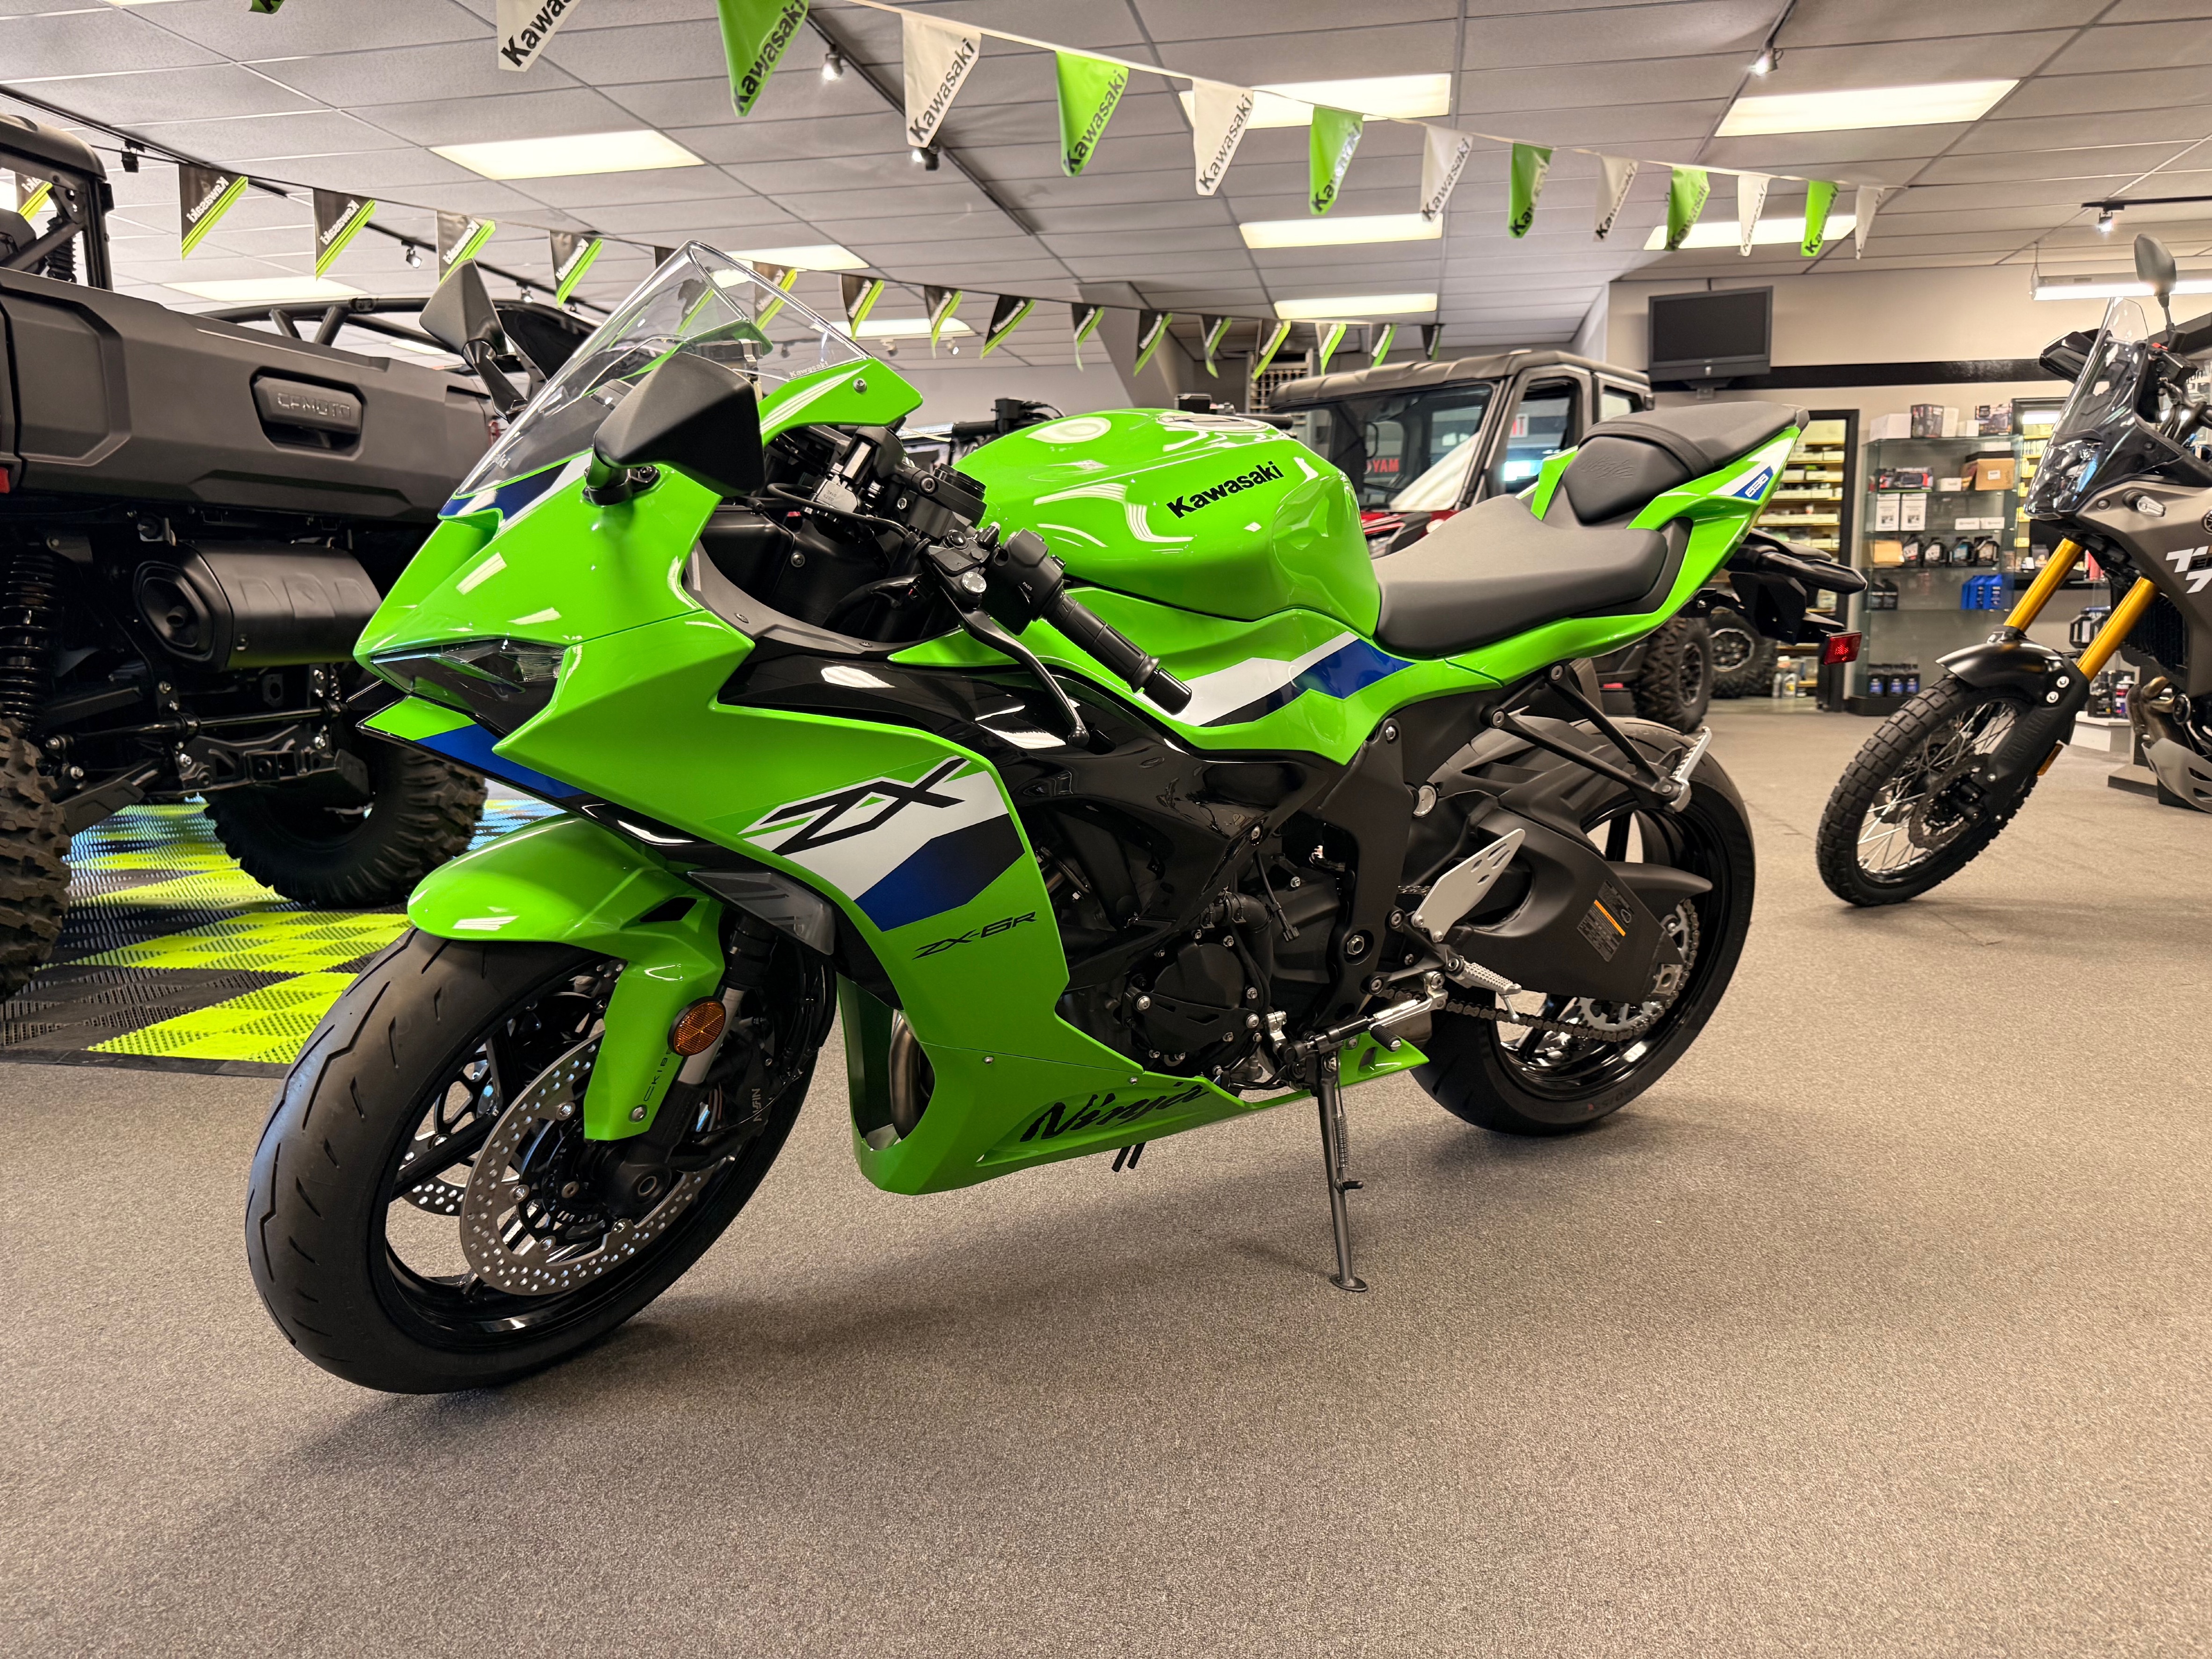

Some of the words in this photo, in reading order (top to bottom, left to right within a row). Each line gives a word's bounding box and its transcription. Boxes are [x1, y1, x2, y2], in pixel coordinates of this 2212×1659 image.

[501, 0, 572, 67] Kawa
[733, 0, 805, 113] Kawasaki
[909, 37, 974, 143] Kawasaki
[1064, 70, 1125, 175] Kawasaki
[1198, 93, 1254, 191] Kawasaki
[1422, 138, 1470, 221] Kawasaki
[789, 361, 828, 378] Kawasaki
[277, 393, 351, 420] CFMOTO
[1166, 461, 1284, 518] Kawasaki
[1372, 458, 1399, 473] YAM
[1744, 473, 1769, 498] 636
[759, 756, 971, 857] ZX
[912, 911, 1037, 960] ZX-6R
[1020, 1081, 1210, 1142] Ninja
